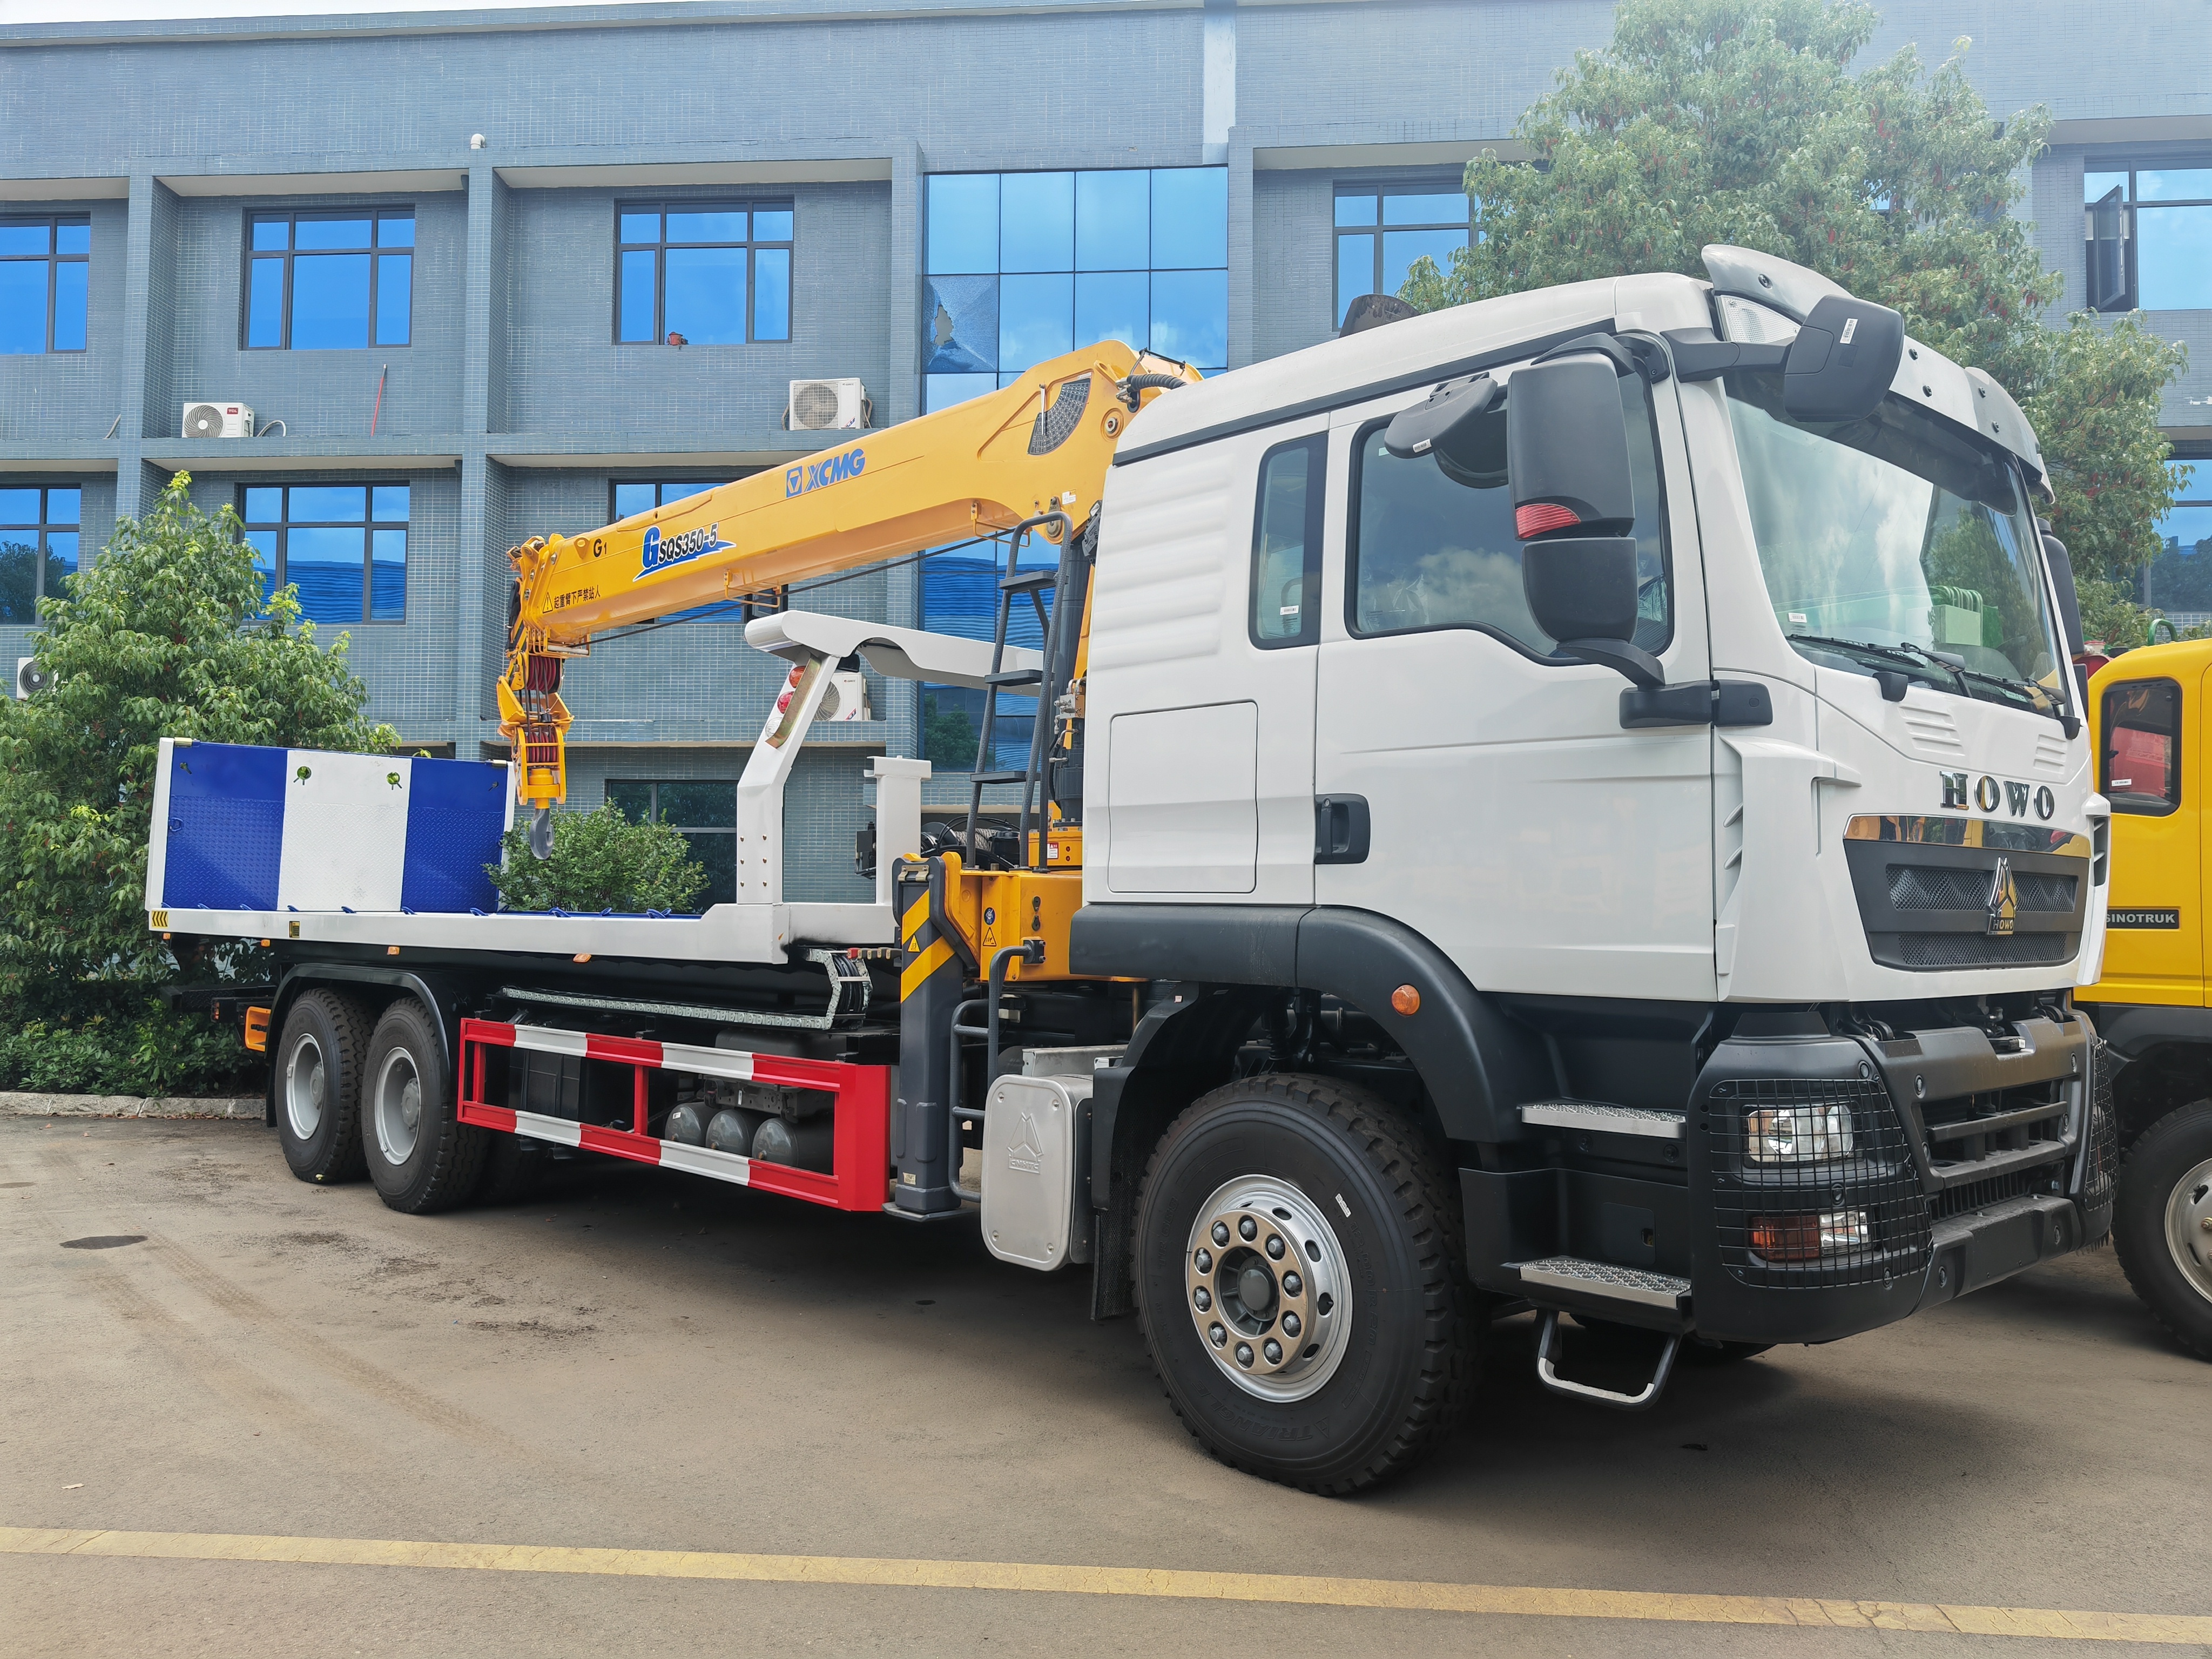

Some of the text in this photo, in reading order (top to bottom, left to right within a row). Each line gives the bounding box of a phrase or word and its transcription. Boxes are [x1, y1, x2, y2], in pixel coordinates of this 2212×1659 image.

[804, 448, 865, 493] XCMG
[554, 585, 601, 609] 起重臂下严禁站人
[1939, 771, 2055, 821] HOWO
[1993, 920, 2014, 929] HOWO
[1010, 1159, 1039, 1170] CNHTC
[1191, 1380, 1313, 1441] TRIANGLE
